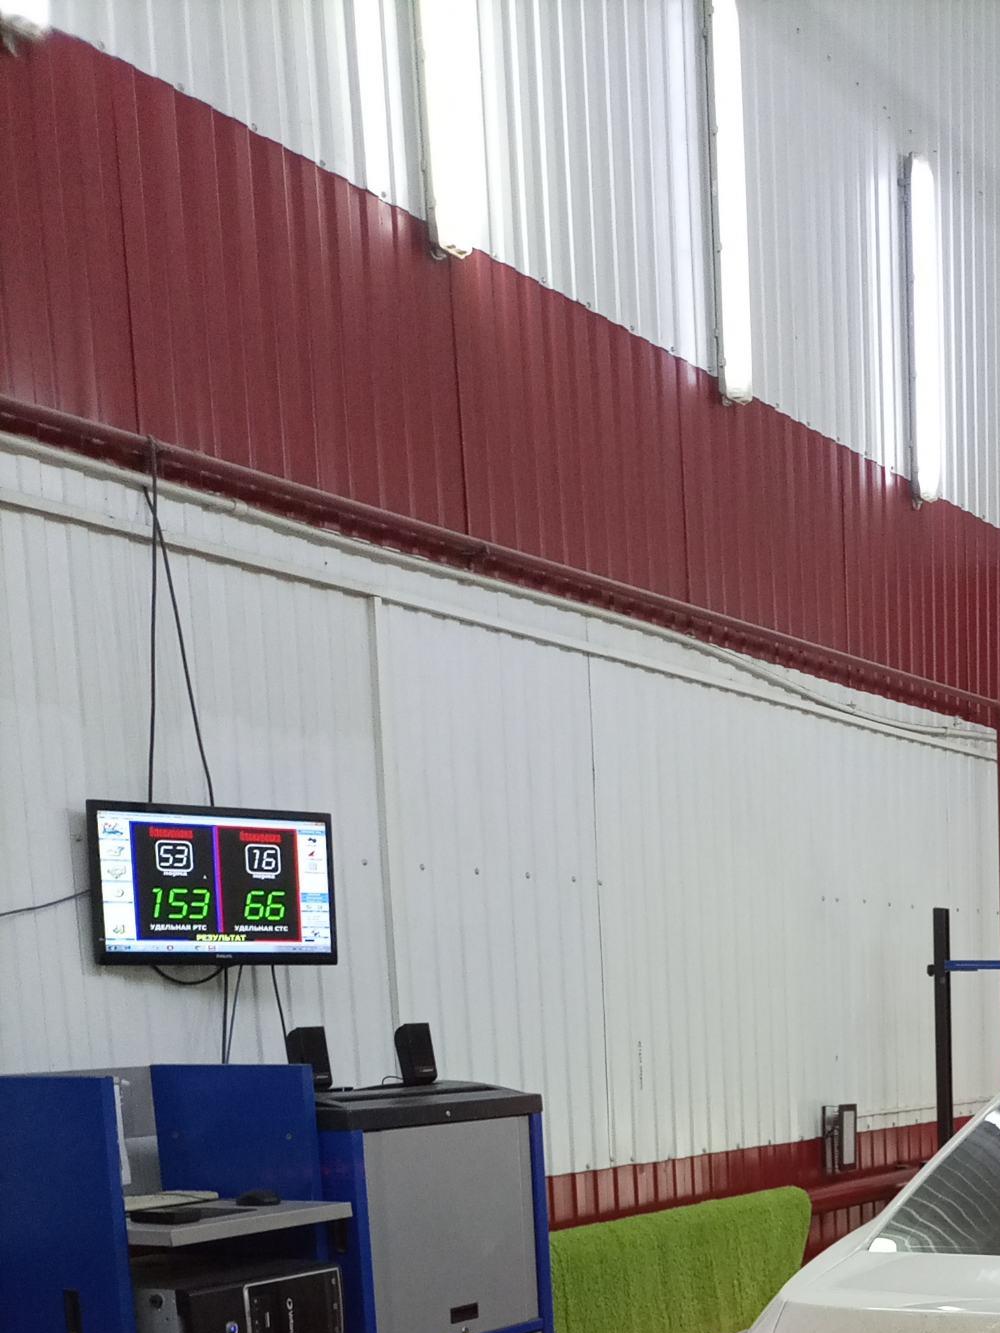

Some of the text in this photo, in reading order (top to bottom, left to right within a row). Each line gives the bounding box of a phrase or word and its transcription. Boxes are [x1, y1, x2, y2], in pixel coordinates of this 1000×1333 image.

[159, 845, 189, 867] 53
[252, 849, 276, 870] 16
[151, 887, 211, 920] 153
[243, 890, 286, 921] 66
[196, 933, 247, 942] РЕЗУЛЬТАТ
